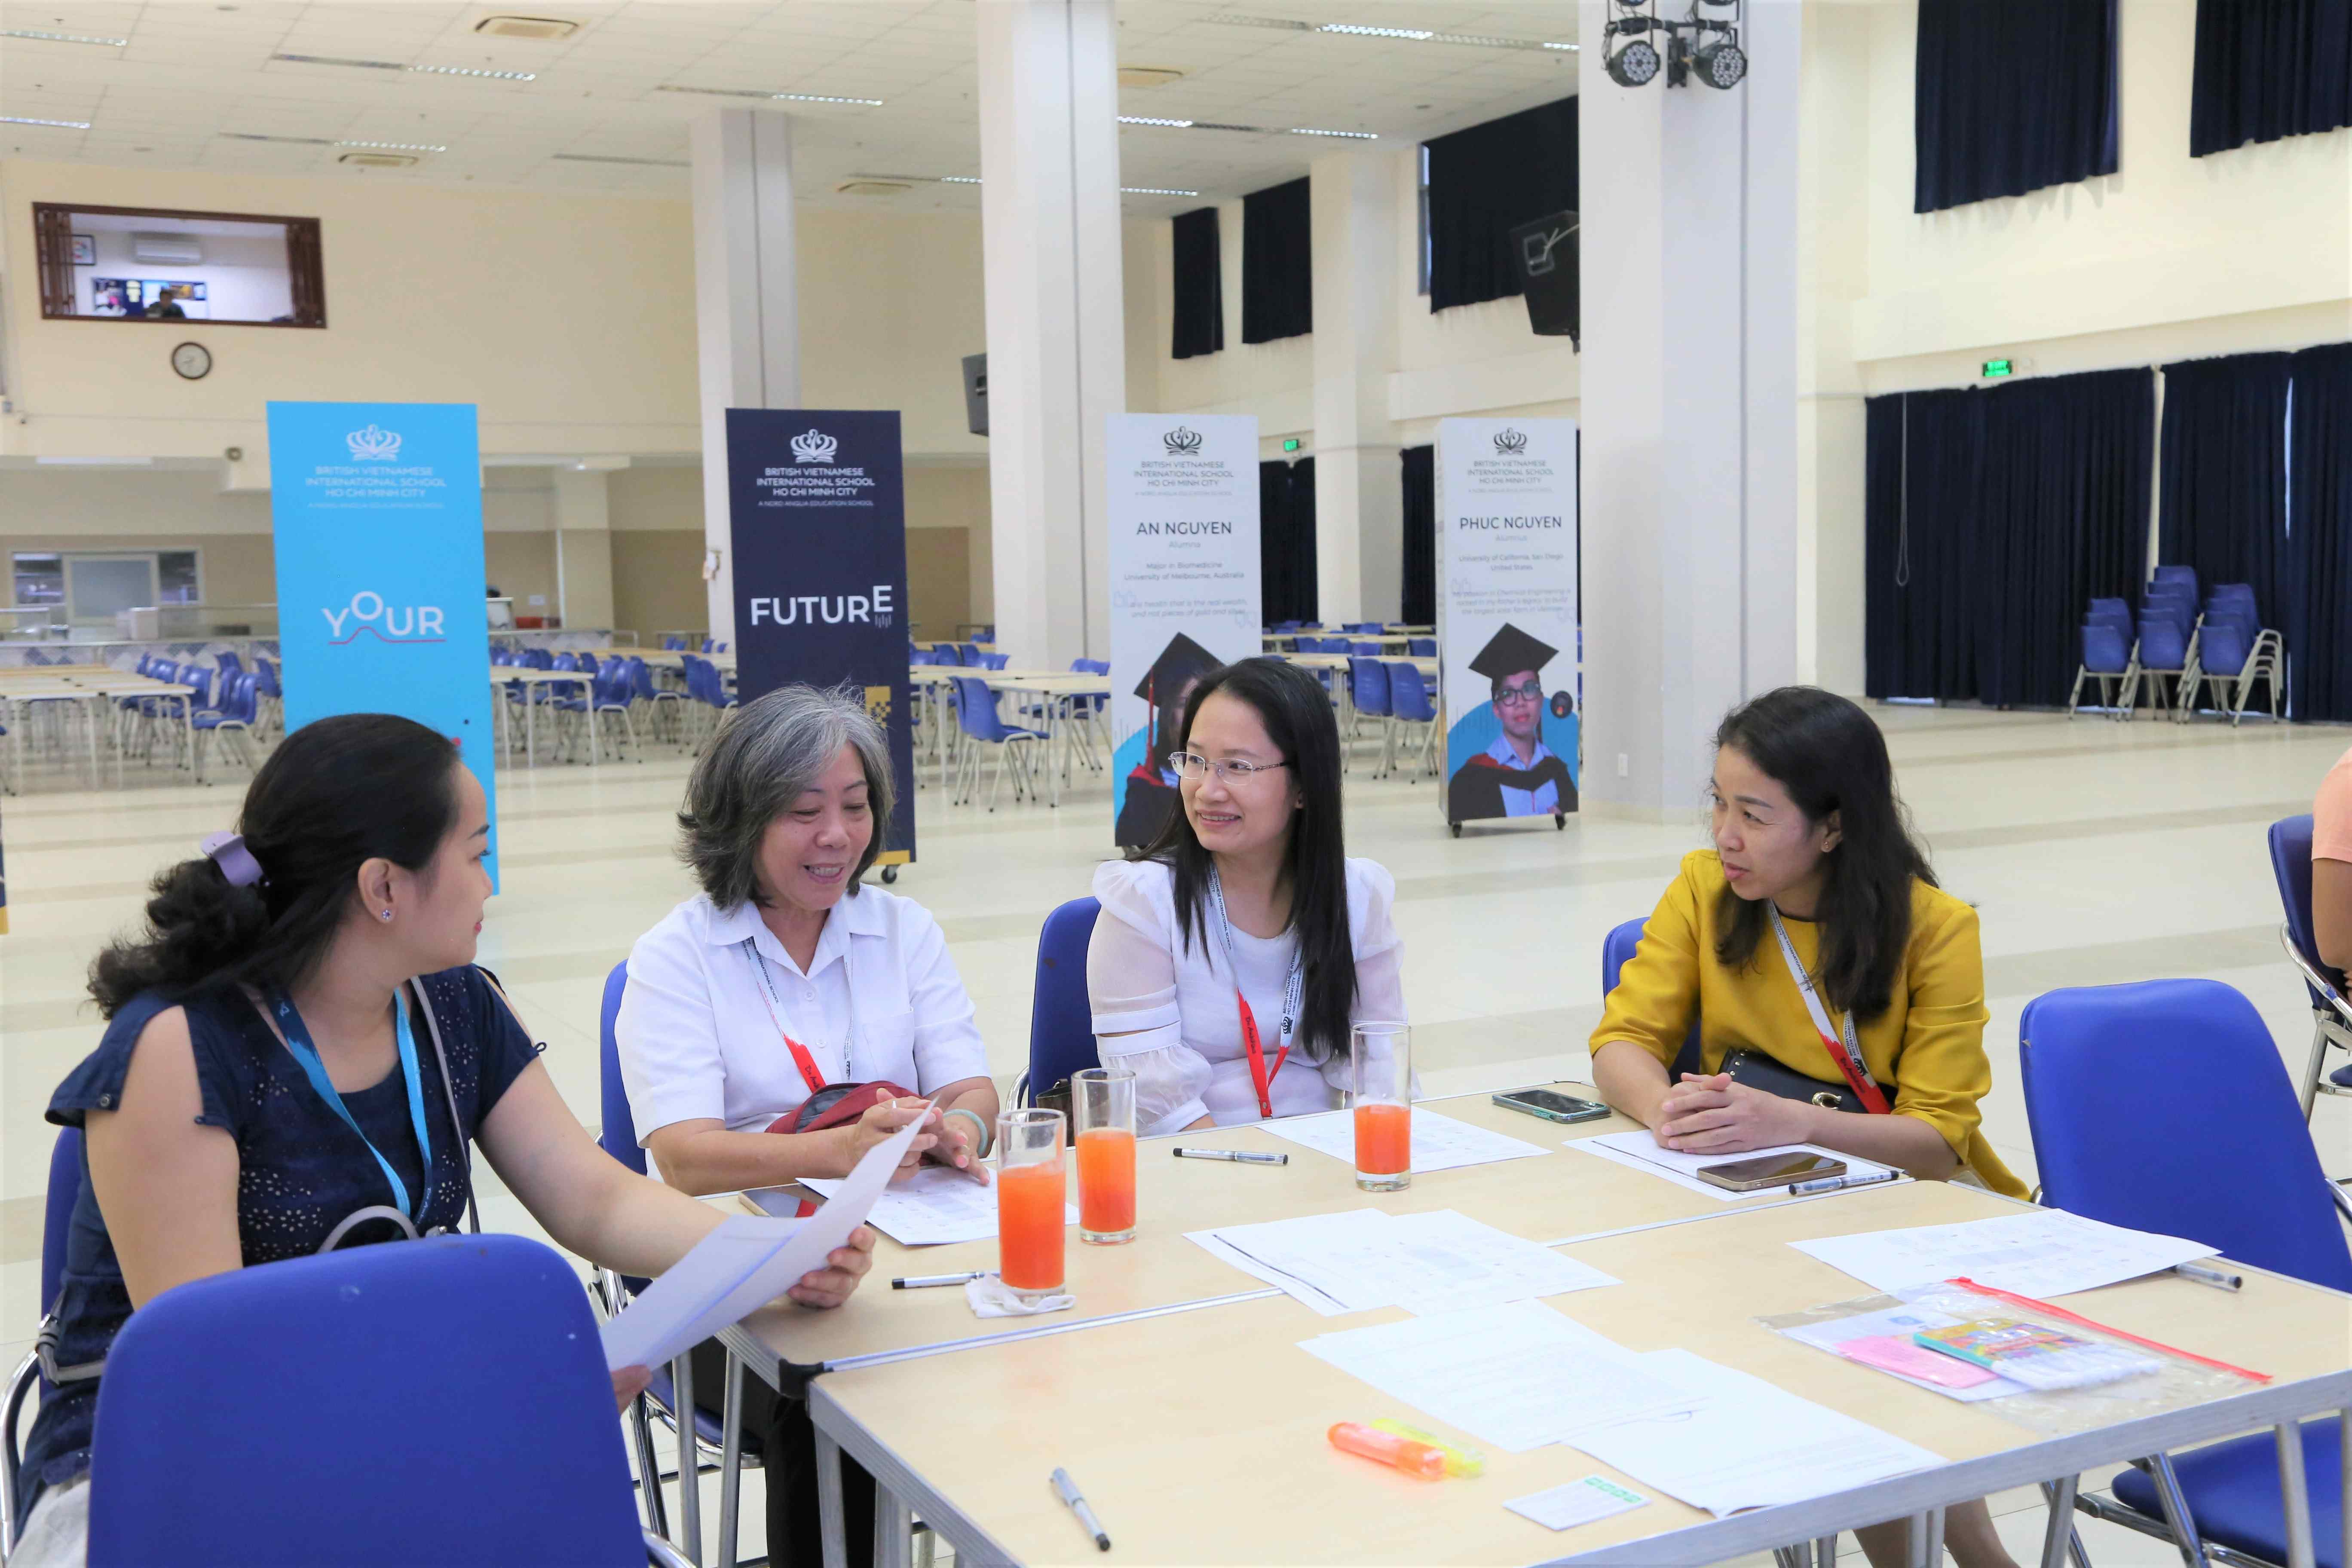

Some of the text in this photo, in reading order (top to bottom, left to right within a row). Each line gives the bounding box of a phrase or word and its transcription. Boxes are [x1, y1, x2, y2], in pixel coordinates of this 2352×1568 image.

[315, 466, 433, 475] BRITISH VIETNAMESE
[765, 467, 864, 476] BRITISH VIETNAMESE
[306, 478, 446, 487] INTERNATIONAL SCHOOL
[756, 478, 875, 486] INTERNATIONAL SCHOOL
[325, 489, 426, 497] HO CHI MINH CITY
[773, 487, 858, 496] HO CHI MINH CITY
[1460, 516, 1562, 530] PHUC NGUYEN
[1136, 522, 1232, 535] AN NGUYEN
[750, 585, 894, 625] FUTURE
[322, 591, 445, 637] YOUR
[769, 984, 779, 1004] SCHOOL
